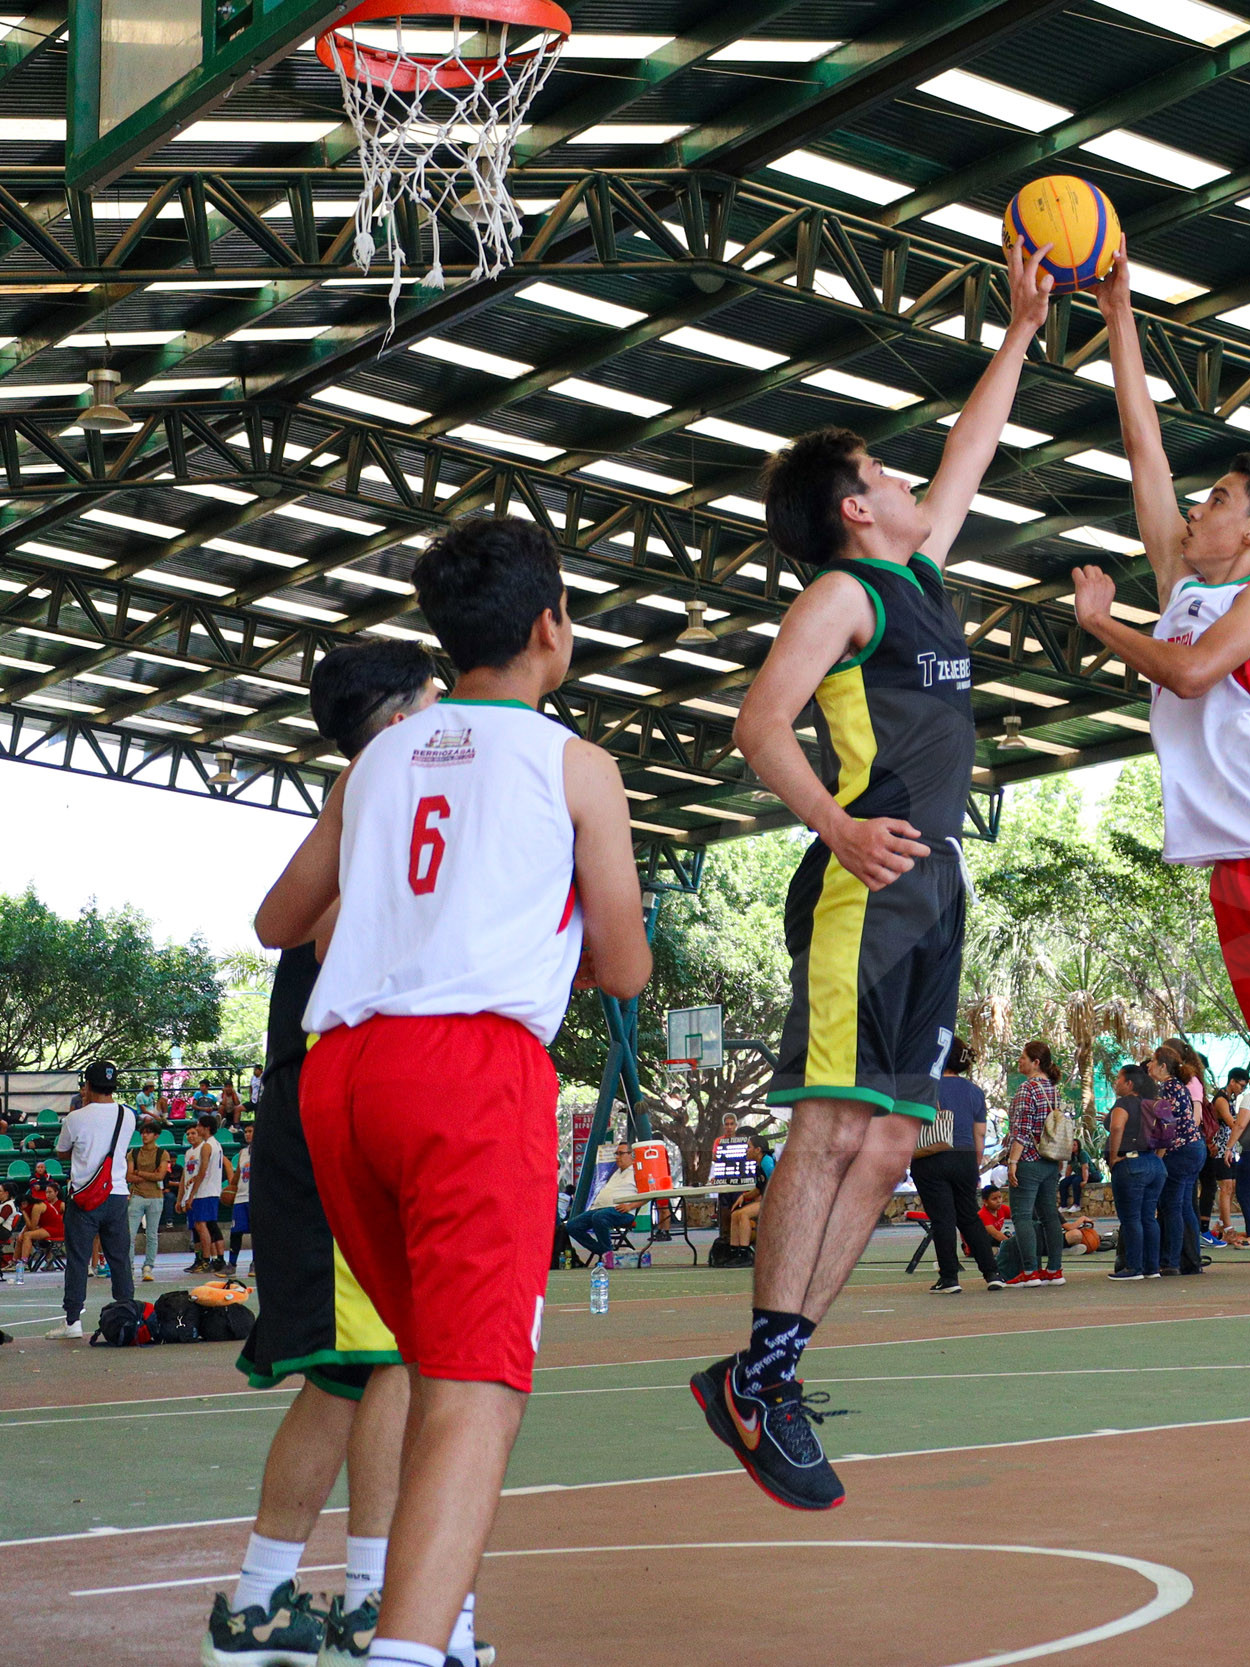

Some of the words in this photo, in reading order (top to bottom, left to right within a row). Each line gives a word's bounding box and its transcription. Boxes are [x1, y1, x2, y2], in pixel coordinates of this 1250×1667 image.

[408, 795, 451, 896] 6
[929, 1026, 953, 1080] 7
[744, 1349, 786, 1379] Supreme
